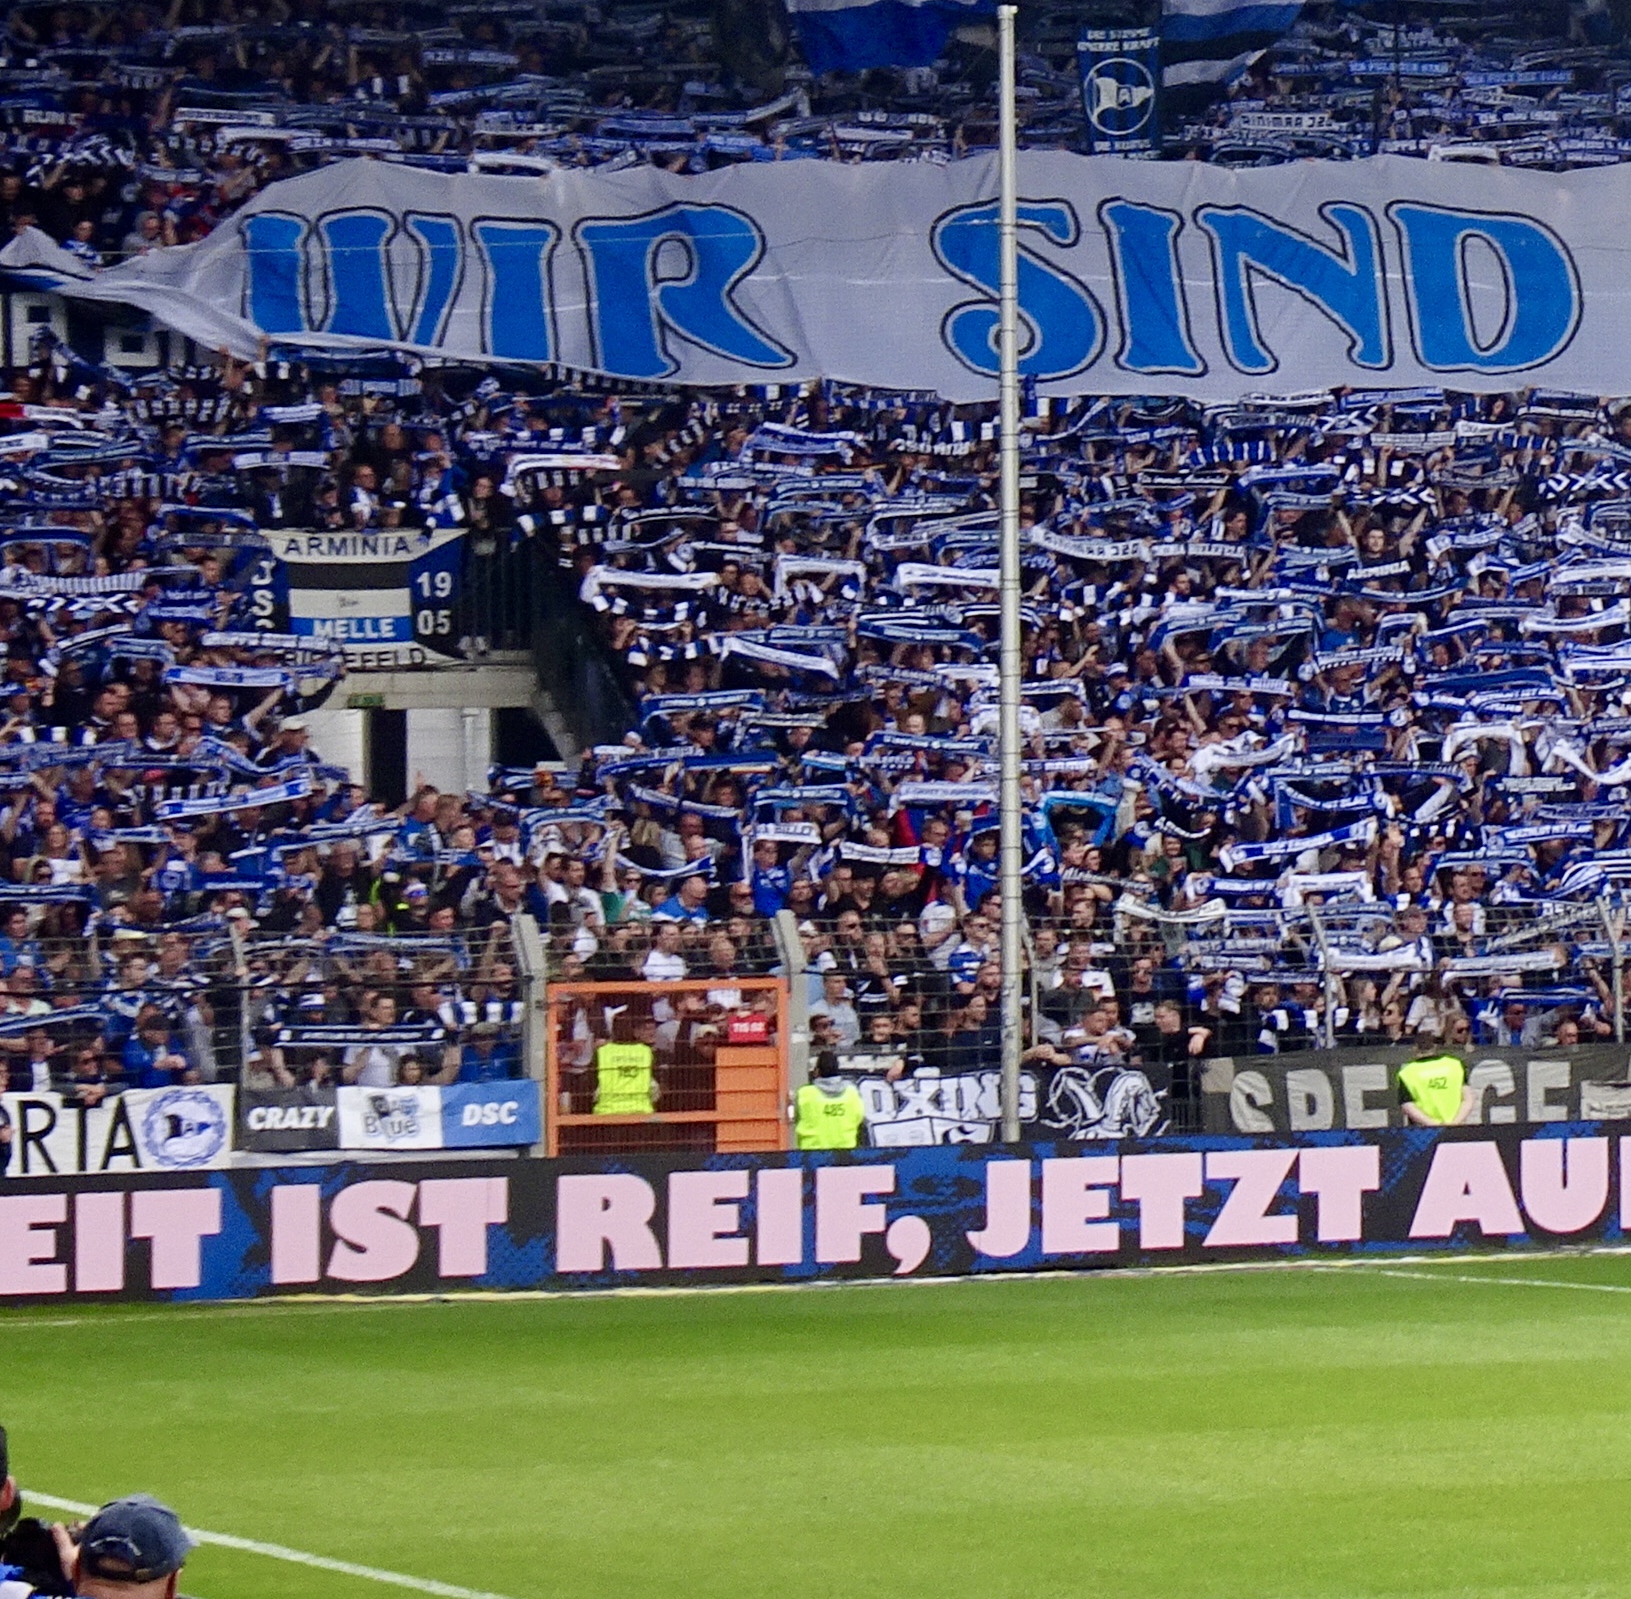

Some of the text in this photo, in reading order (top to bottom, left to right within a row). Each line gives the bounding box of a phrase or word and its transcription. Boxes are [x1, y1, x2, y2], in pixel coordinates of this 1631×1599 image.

[238, 202, 798, 382] WIR
[929, 196, 1584, 382] SIND
[284, 535, 413, 557] ARMINIA
[416, 571, 453, 599] 19
[312, 617, 397, 640] MELLE
[416, 608, 453, 636] 05
[247, 1104, 336, 1132] CRAZY
[462, 1100, 520, 1127] DSC
[0, 1187, 222, 1296] EIT
[271, 1176, 508, 1285] IST
[556, 1164, 933, 1275] REIF,
[967, 1145, 1381, 1259] JETZT
